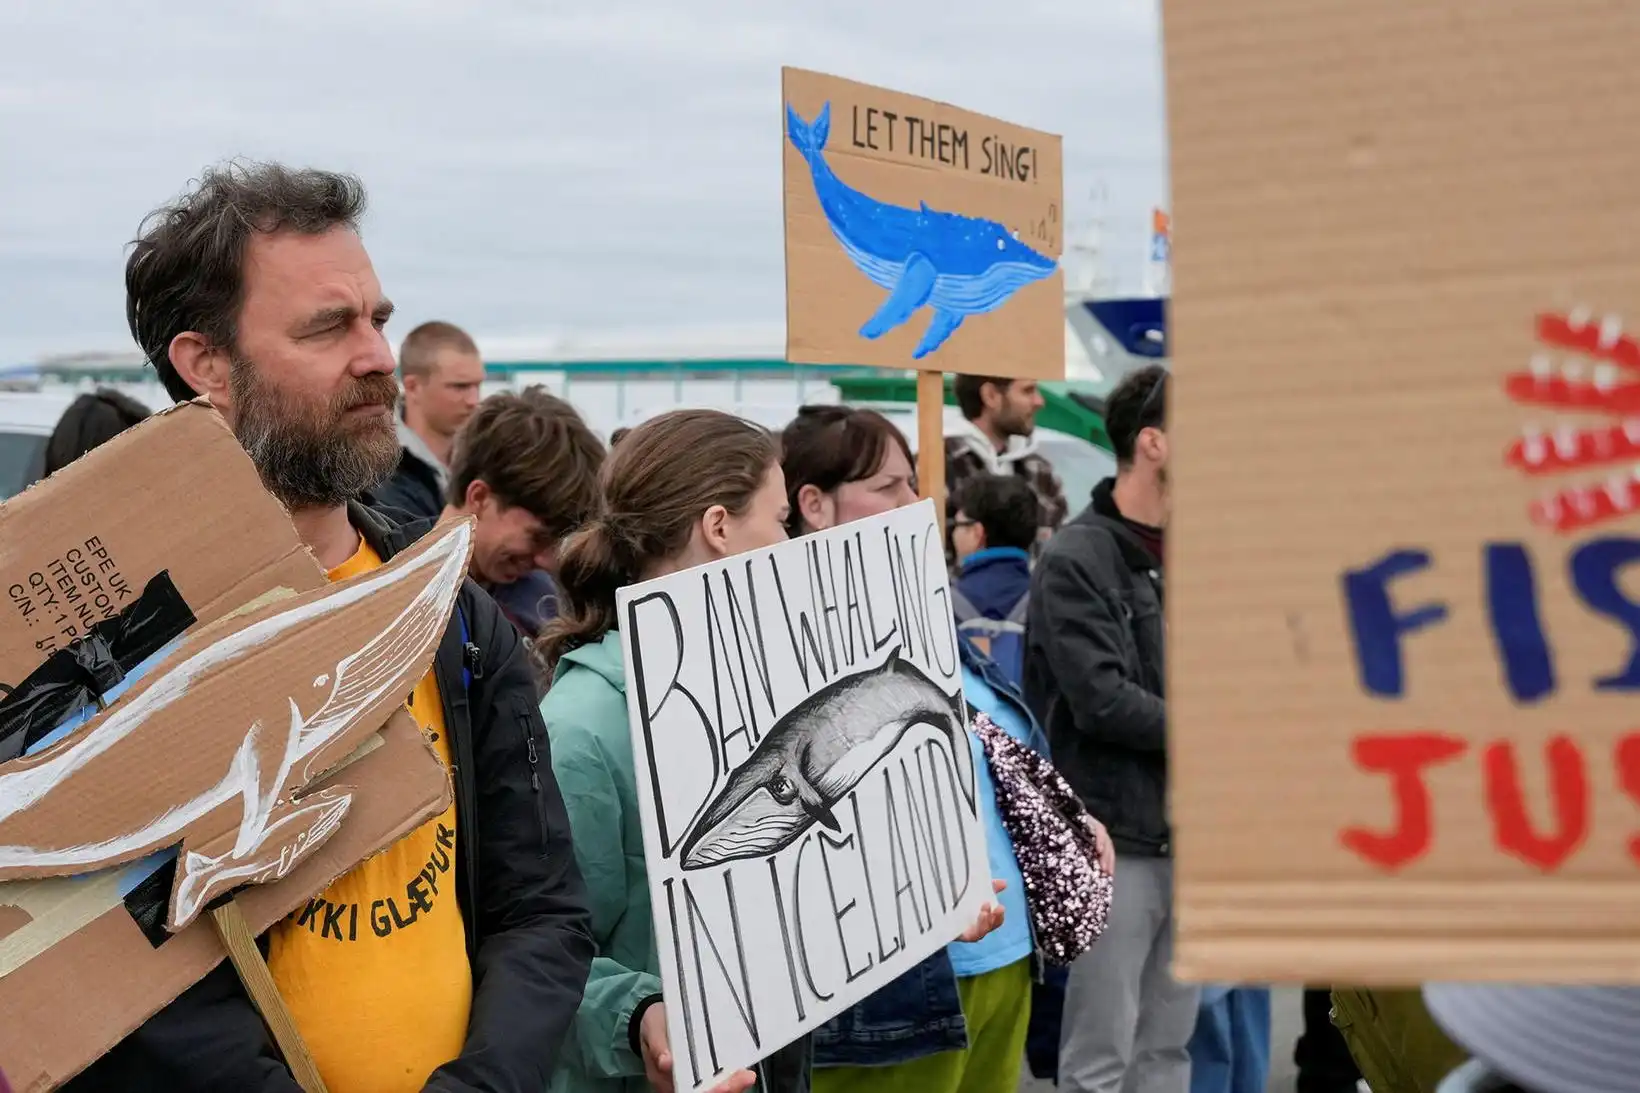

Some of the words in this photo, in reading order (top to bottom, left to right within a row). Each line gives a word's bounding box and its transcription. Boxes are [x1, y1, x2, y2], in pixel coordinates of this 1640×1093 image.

[852, 105, 898, 152] LET
[904, 116, 970, 170] THEM
[28, 571, 60, 615] QTY:
[55, 613, 68, 624] 1
[47, 559, 82, 604] ITEM
[84, 535, 116, 574] EPE
[108, 572, 133, 601] UK
[628, 559, 777, 859] BAN
[769, 522, 957, 693] WHALING
[1338, 727, 1640, 877] JU
[288, 897, 358, 942] KKI
[662, 867, 761, 1089] IN
[765, 737, 970, 1023] ICELAND
